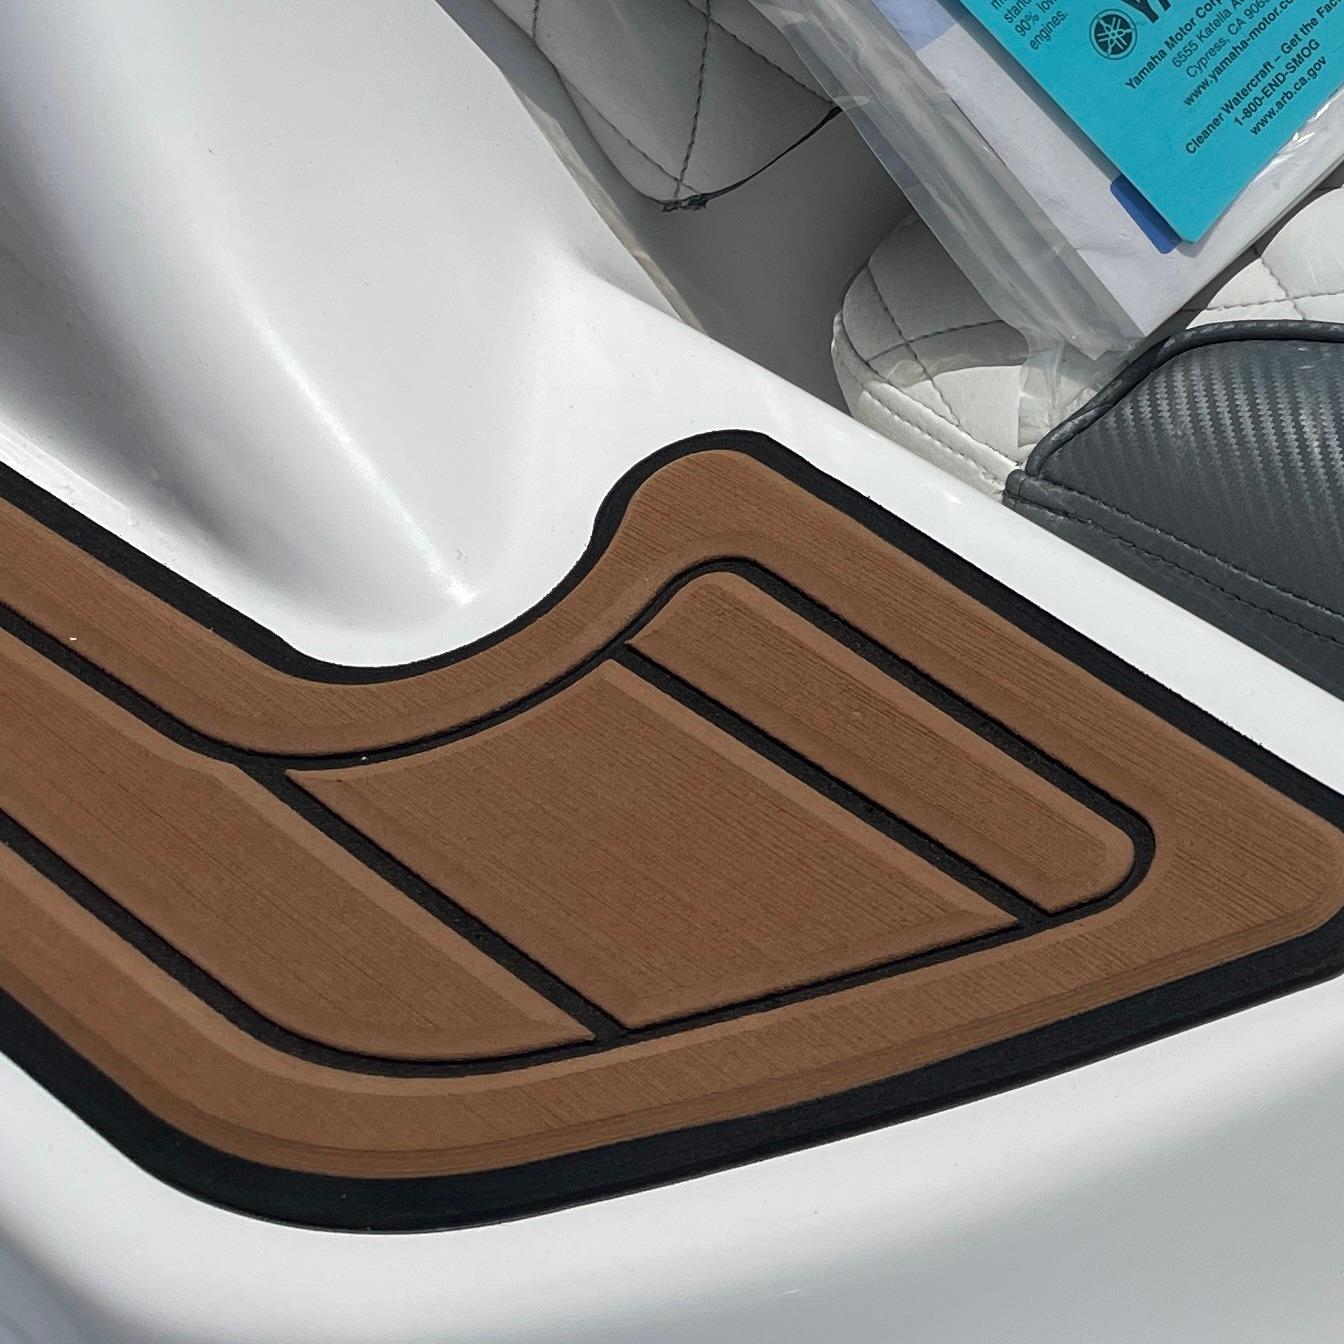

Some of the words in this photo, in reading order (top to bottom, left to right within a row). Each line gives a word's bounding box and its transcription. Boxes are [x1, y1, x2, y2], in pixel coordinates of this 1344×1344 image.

[1014, 11, 1040, 37] 90%
[1029, 10, 1068, 50] engines.
[1125, 49, 1168, 89] Yamaha
[1164, 17, 1196, 51] Motor
[1171, 40, 1199, 68] 6555
[1195, 9, 1232, 43] Katella
[1186, 37, 1231, 78] Cypress,
[1227, 17, 1247, 35] CA
[1185, 112, 1224, 154] Cleaner
[1220, 61, 1275, 114] Watercraft
[1281, 34, 1302, 54] Get
[1299, 17, 1319, 36] the
[1234, 39, 1321, 126] 1-800-END-SMOG
[1249, 56, 1326, 135] www.arb.ca.gov
